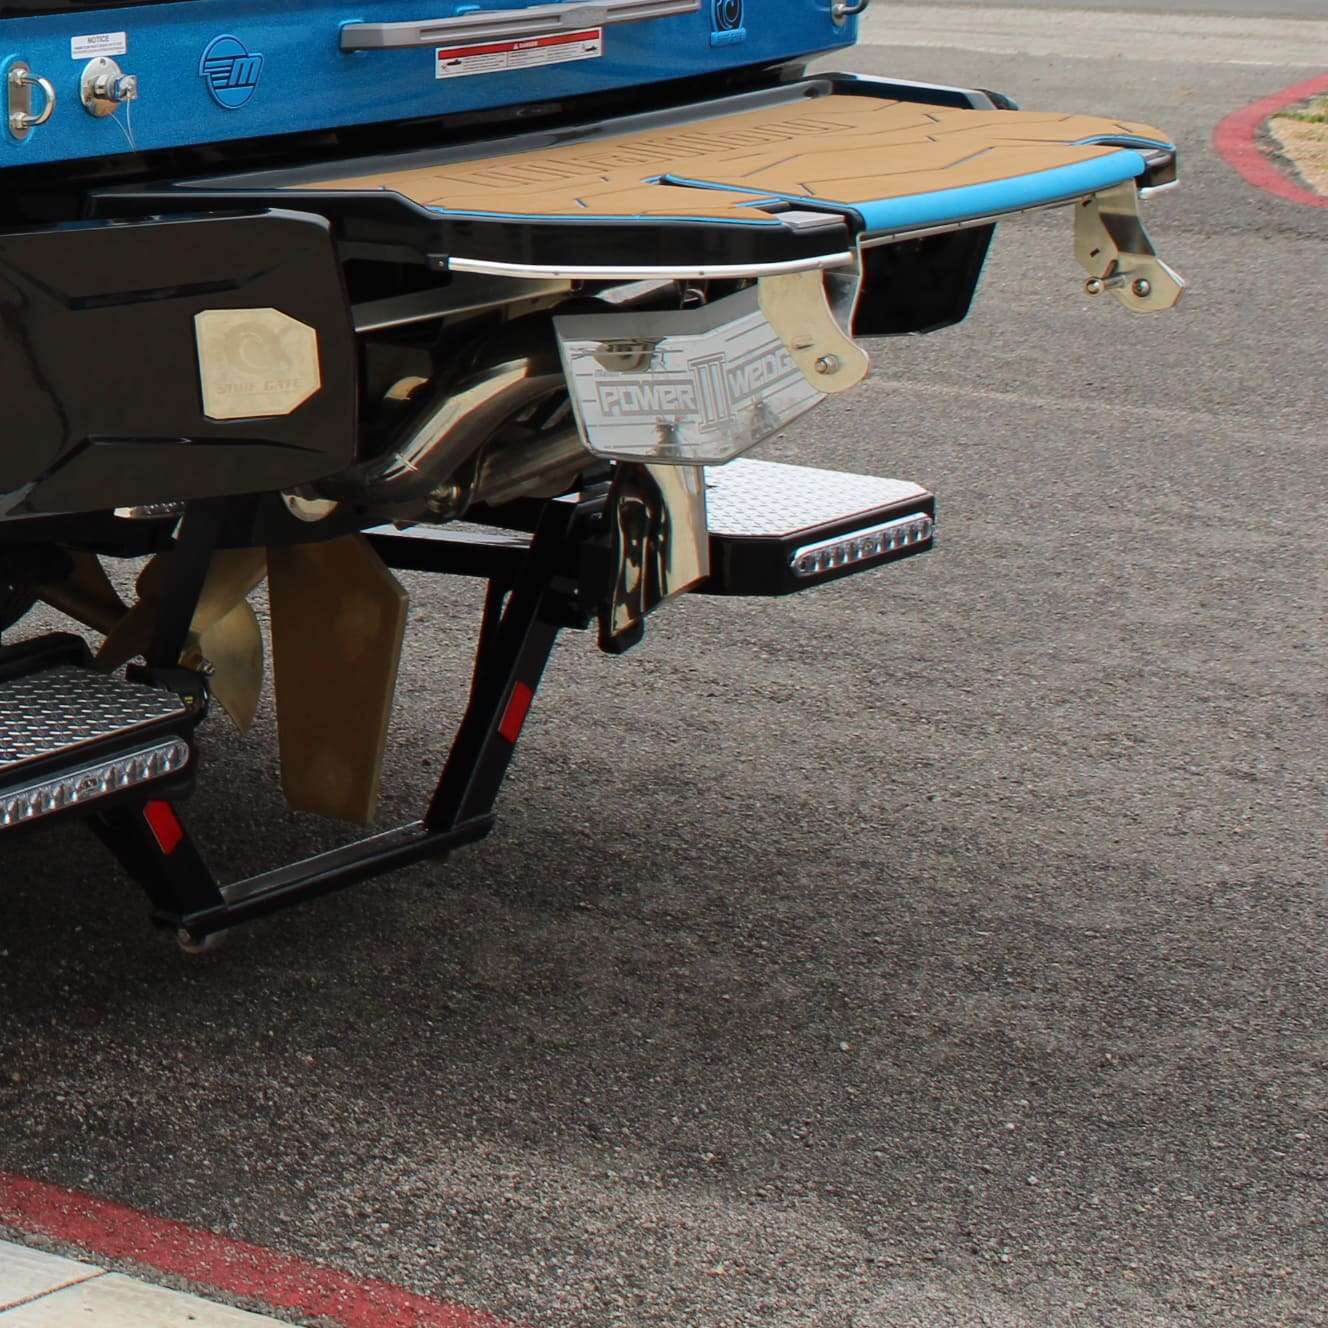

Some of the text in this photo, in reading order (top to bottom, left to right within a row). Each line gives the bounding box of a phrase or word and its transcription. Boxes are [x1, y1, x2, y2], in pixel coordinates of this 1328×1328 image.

[264, 378, 304, 392] GATE
[599, 383, 696, 416] POWER
[728, 350, 793, 401] WEDG
